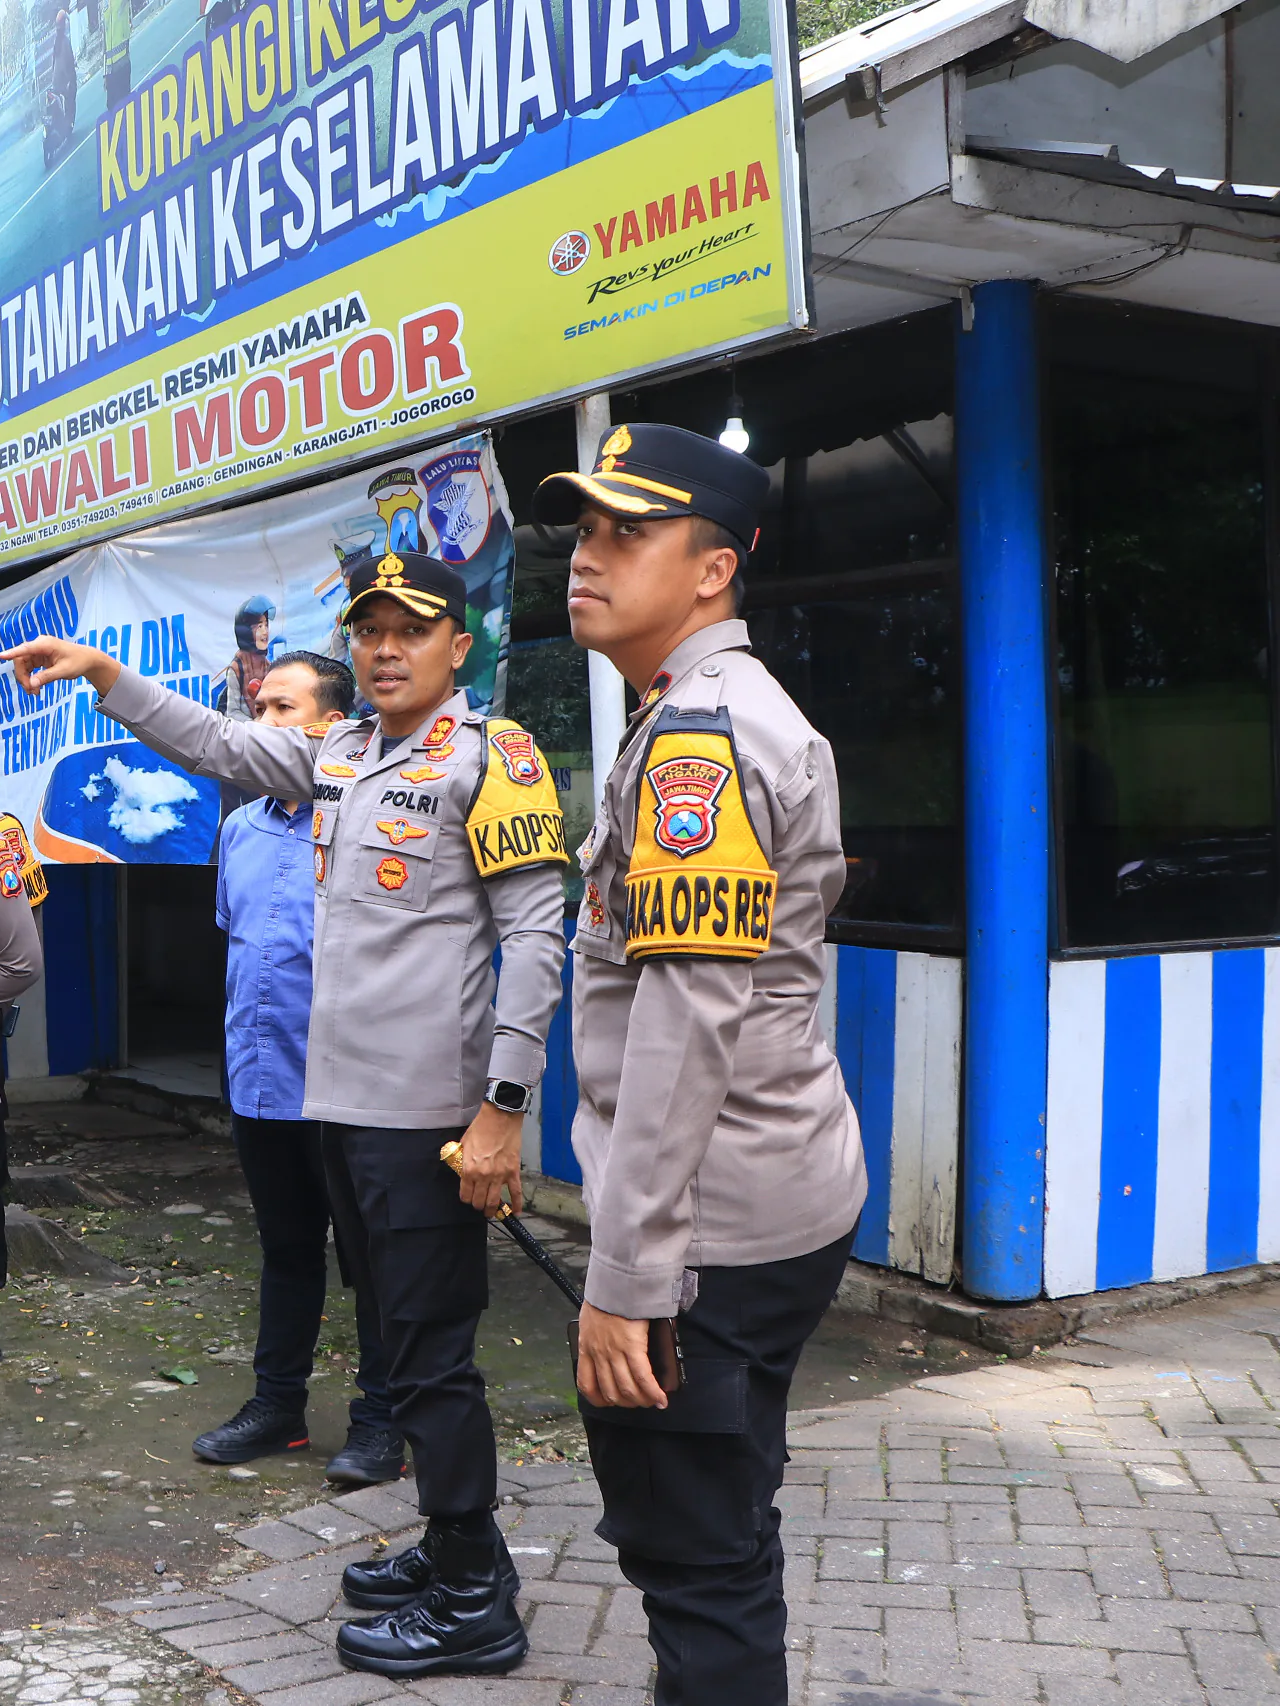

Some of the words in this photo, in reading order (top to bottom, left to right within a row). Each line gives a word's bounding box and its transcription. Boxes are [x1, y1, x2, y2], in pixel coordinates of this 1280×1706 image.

[99, 0, 294, 213] KURANGI
[593, 160, 770, 260] YAMAHA
[587, 263, 650, 305] Revs
[698, 222, 755, 254] Heart
[563, 299, 659, 341] SEMAKIN
[663, 289, 686, 308] DI
[689, 263, 772, 300] DEPAN
[23, 424, 62, 458] DAN
[66, 385, 159, 441] BENGKEL
[165, 349, 237, 399] RESMI
[242, 298, 366, 368] YAMAHA
[174, 308, 466, 472] MOTOR
[0, 541, 10, 551] 32
[10, 533, 37, 548] NGAWI
[38, 526, 60, 542] TELP.
[61, 508, 118, 534] 0351-749203,
[120, 494, 154, 513] 749416
[161, 476, 205, 500] CABANG
[214, 451, 283, 482] GENDINGAN
[293, 419, 378, 456] KARANGJATI
[390, 388, 475, 426] JOGOROGO
[425, 463, 447, 480] LALU
[139, 613, 191, 677] DIA
[1, 713, 51, 776] TENTU
[658, 764, 718, 778] POLRES
[665, 770, 710, 780] NGAWI
[381, 790, 439, 815] POLRI
[665, 785, 687, 795] JAWA
[687, 784, 710, 795] TIMUR
[671, 875, 730, 937] OPS
[734, 878, 773, 941] RES
